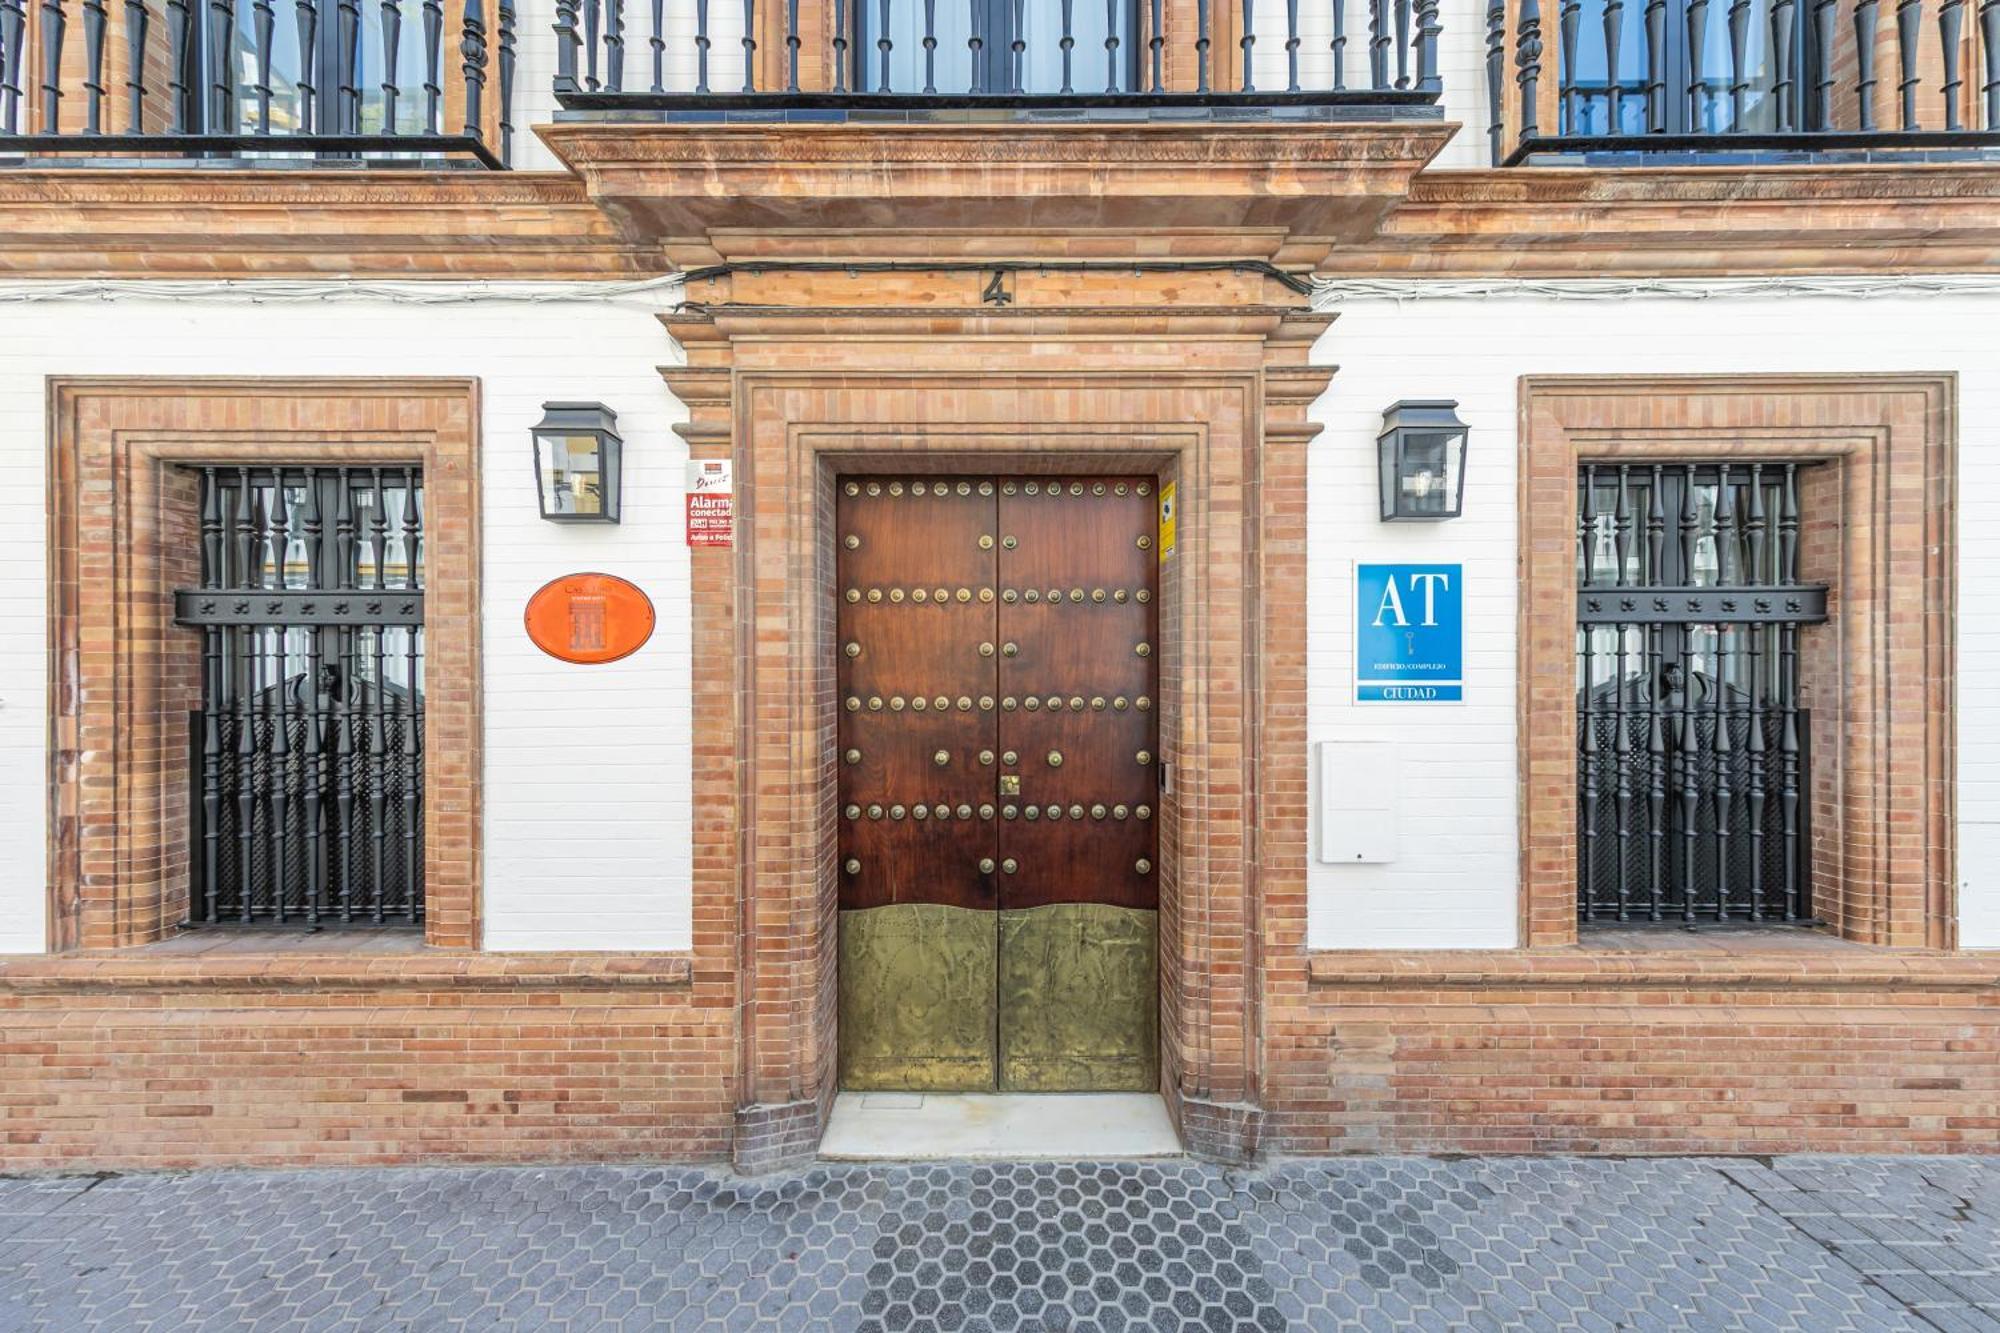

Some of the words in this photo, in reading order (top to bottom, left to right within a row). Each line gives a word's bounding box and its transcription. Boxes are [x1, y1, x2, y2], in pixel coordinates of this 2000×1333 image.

[983, 270, 1011, 306] 4
[690, 508, 732, 517] conectad
[1372, 574, 1449, 626] AT
[1383, 687, 1437, 699] CIUDAD
